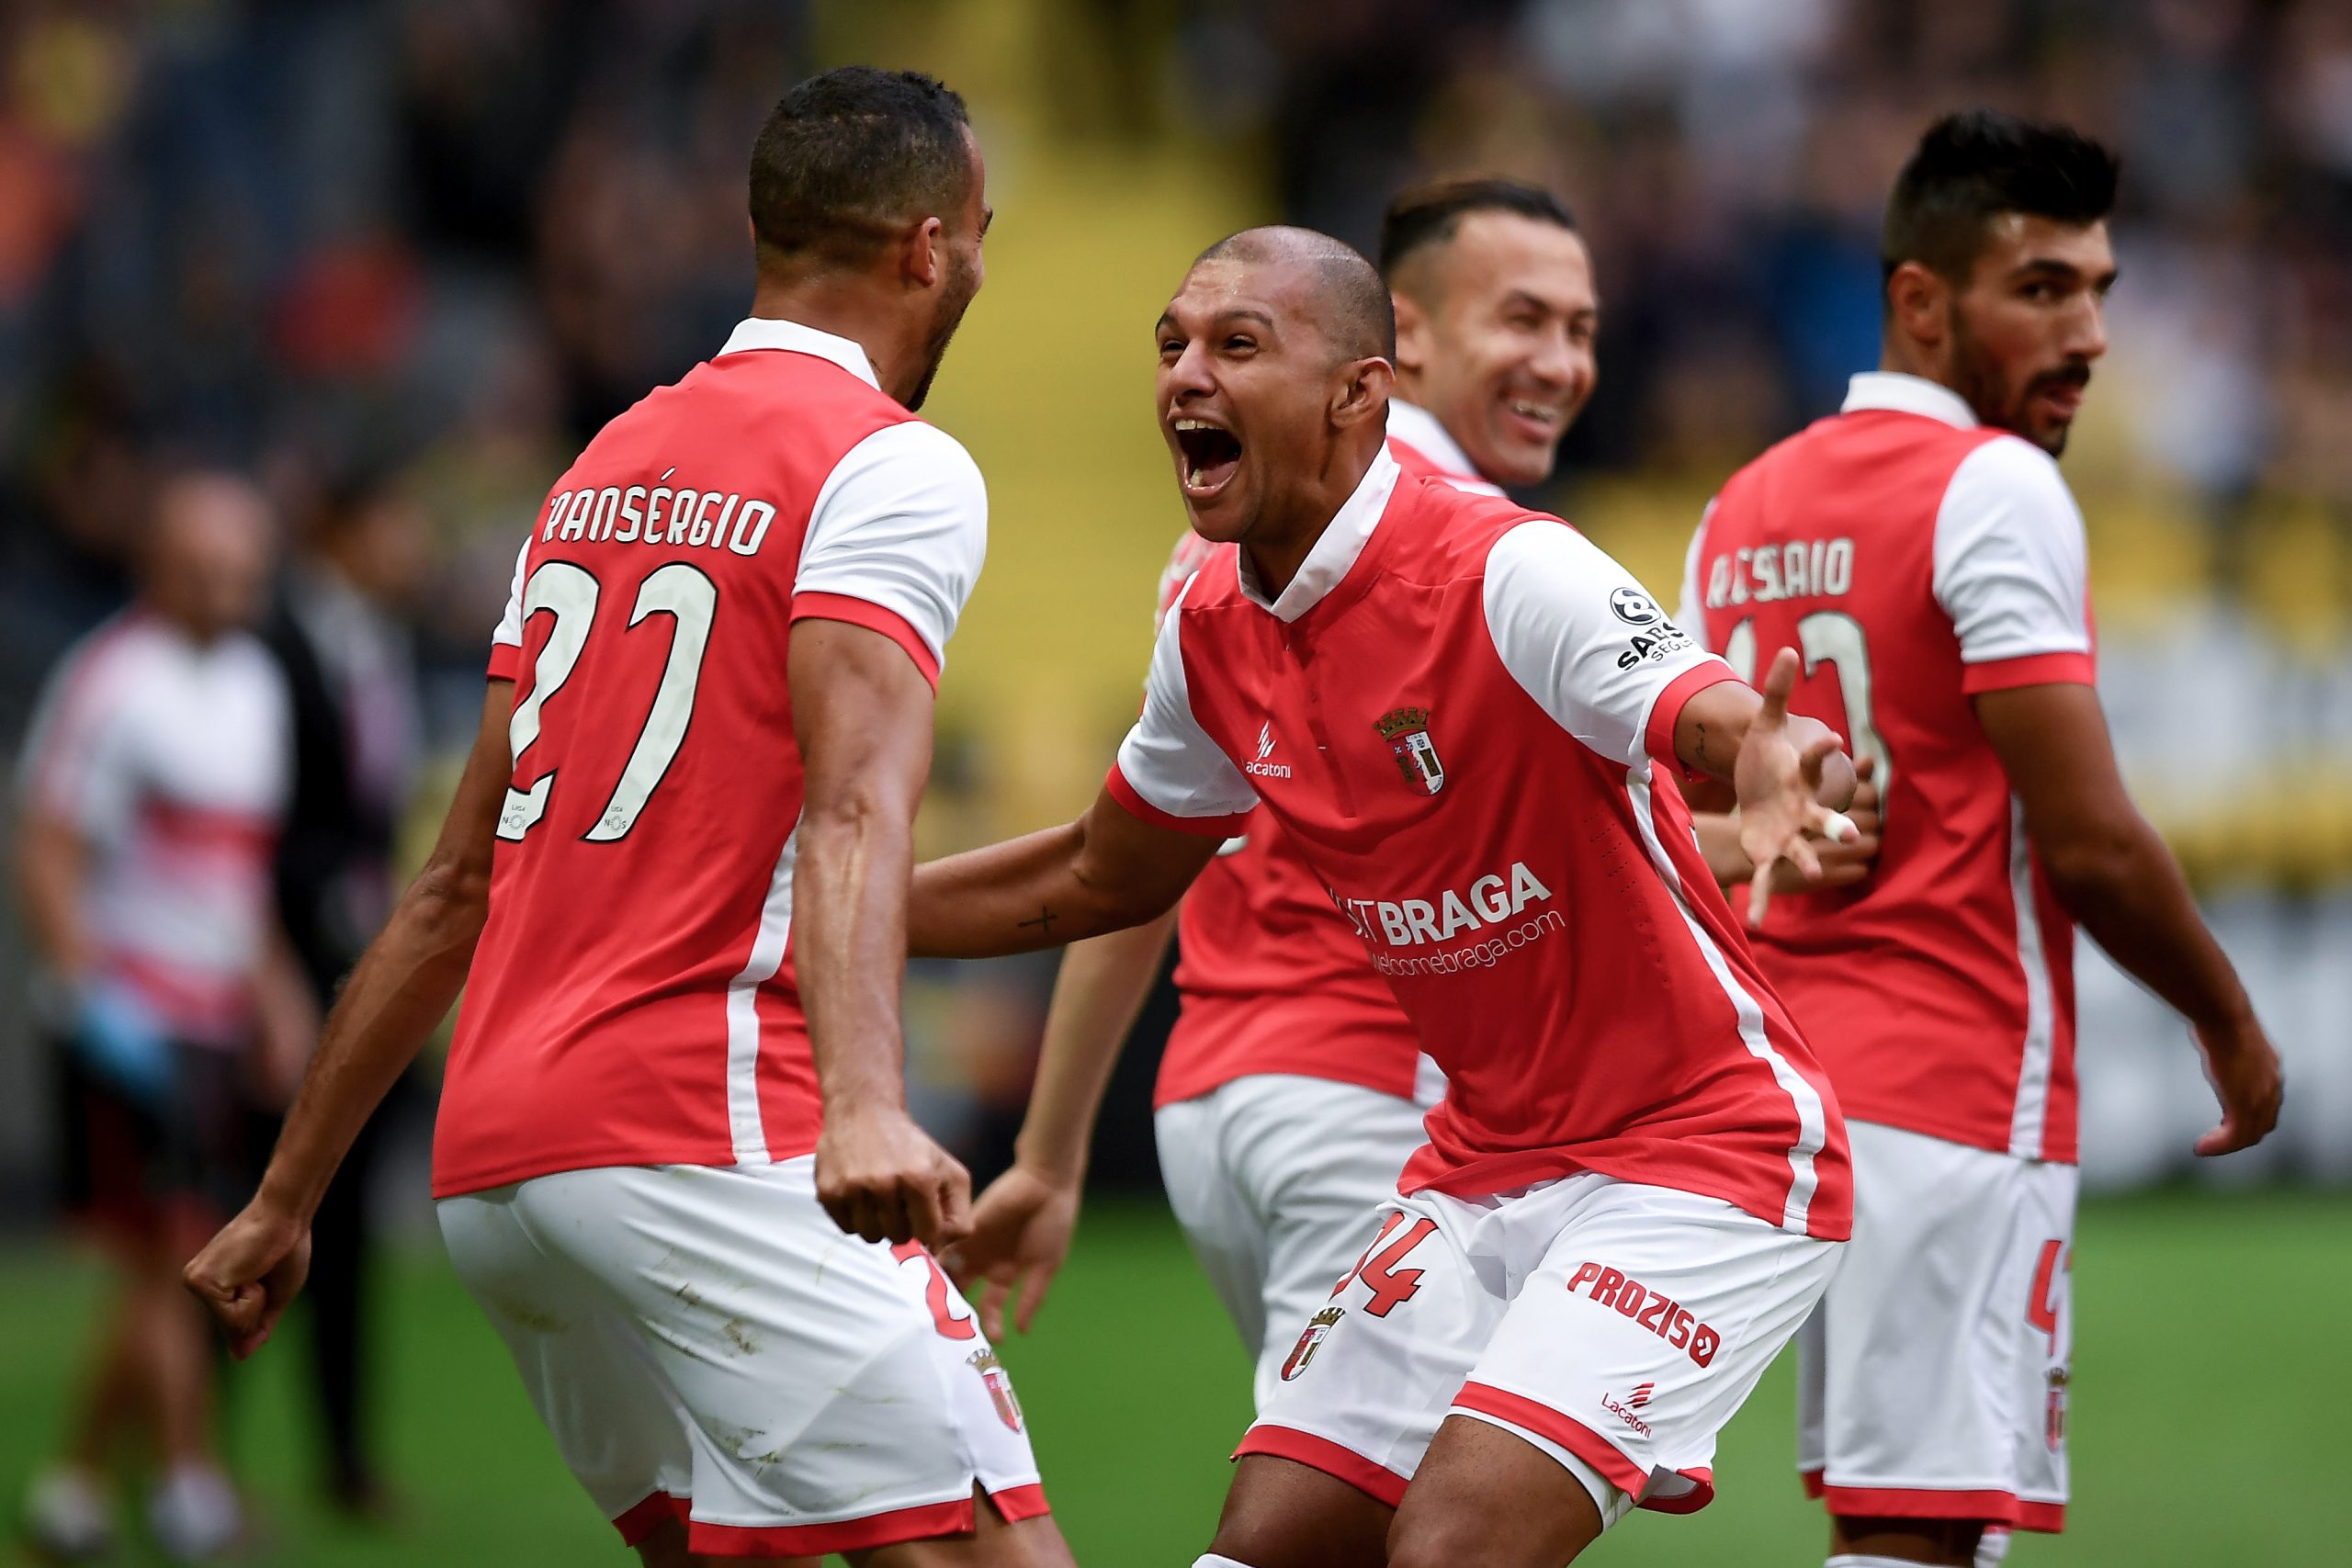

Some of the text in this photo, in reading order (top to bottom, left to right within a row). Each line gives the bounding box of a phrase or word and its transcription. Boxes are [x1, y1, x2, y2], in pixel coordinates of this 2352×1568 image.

[540, 466, 778, 557] RANSÉRGIO
[494, 558, 720, 842] 27
[1240, 755, 1292, 779] acatoni
[1377, 862, 1554, 947] BRAGA
[1567, 1261, 1695, 1350] PROZIS
[1601, 1392, 1652, 1439] Lacatoni
